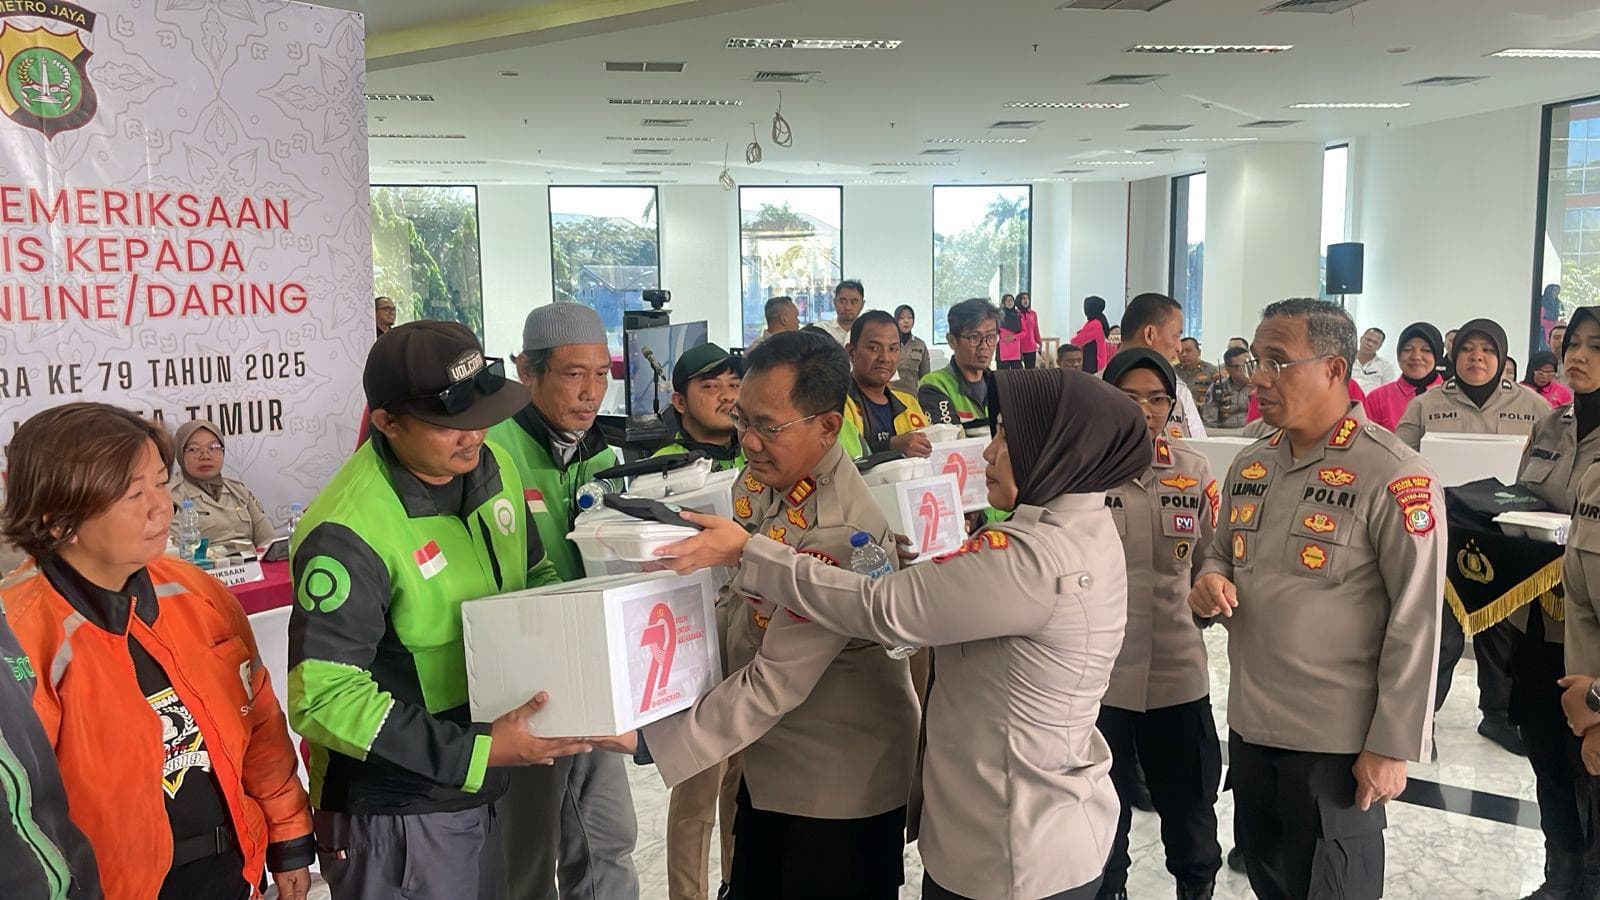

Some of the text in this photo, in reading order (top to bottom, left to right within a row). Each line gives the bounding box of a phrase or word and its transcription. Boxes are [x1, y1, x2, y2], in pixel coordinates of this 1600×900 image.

[50, 5, 86, 25] JAYA
[0, 186, 289, 230] EMERIKSAAN
[3, 236, 244, 273] IS KEPADA
[48, 363, 82, 395] KE
[98, 361, 132, 391] 79
[148, 355, 231, 388] TAHUN
[246, 351, 305, 381] 2025
[1428, 411, 1457, 420] ISMI
[1499, 412, 1535, 421] POLRI
[1161, 495, 1199, 510] POLRI
[1303, 486, 1357, 509] POLRI
